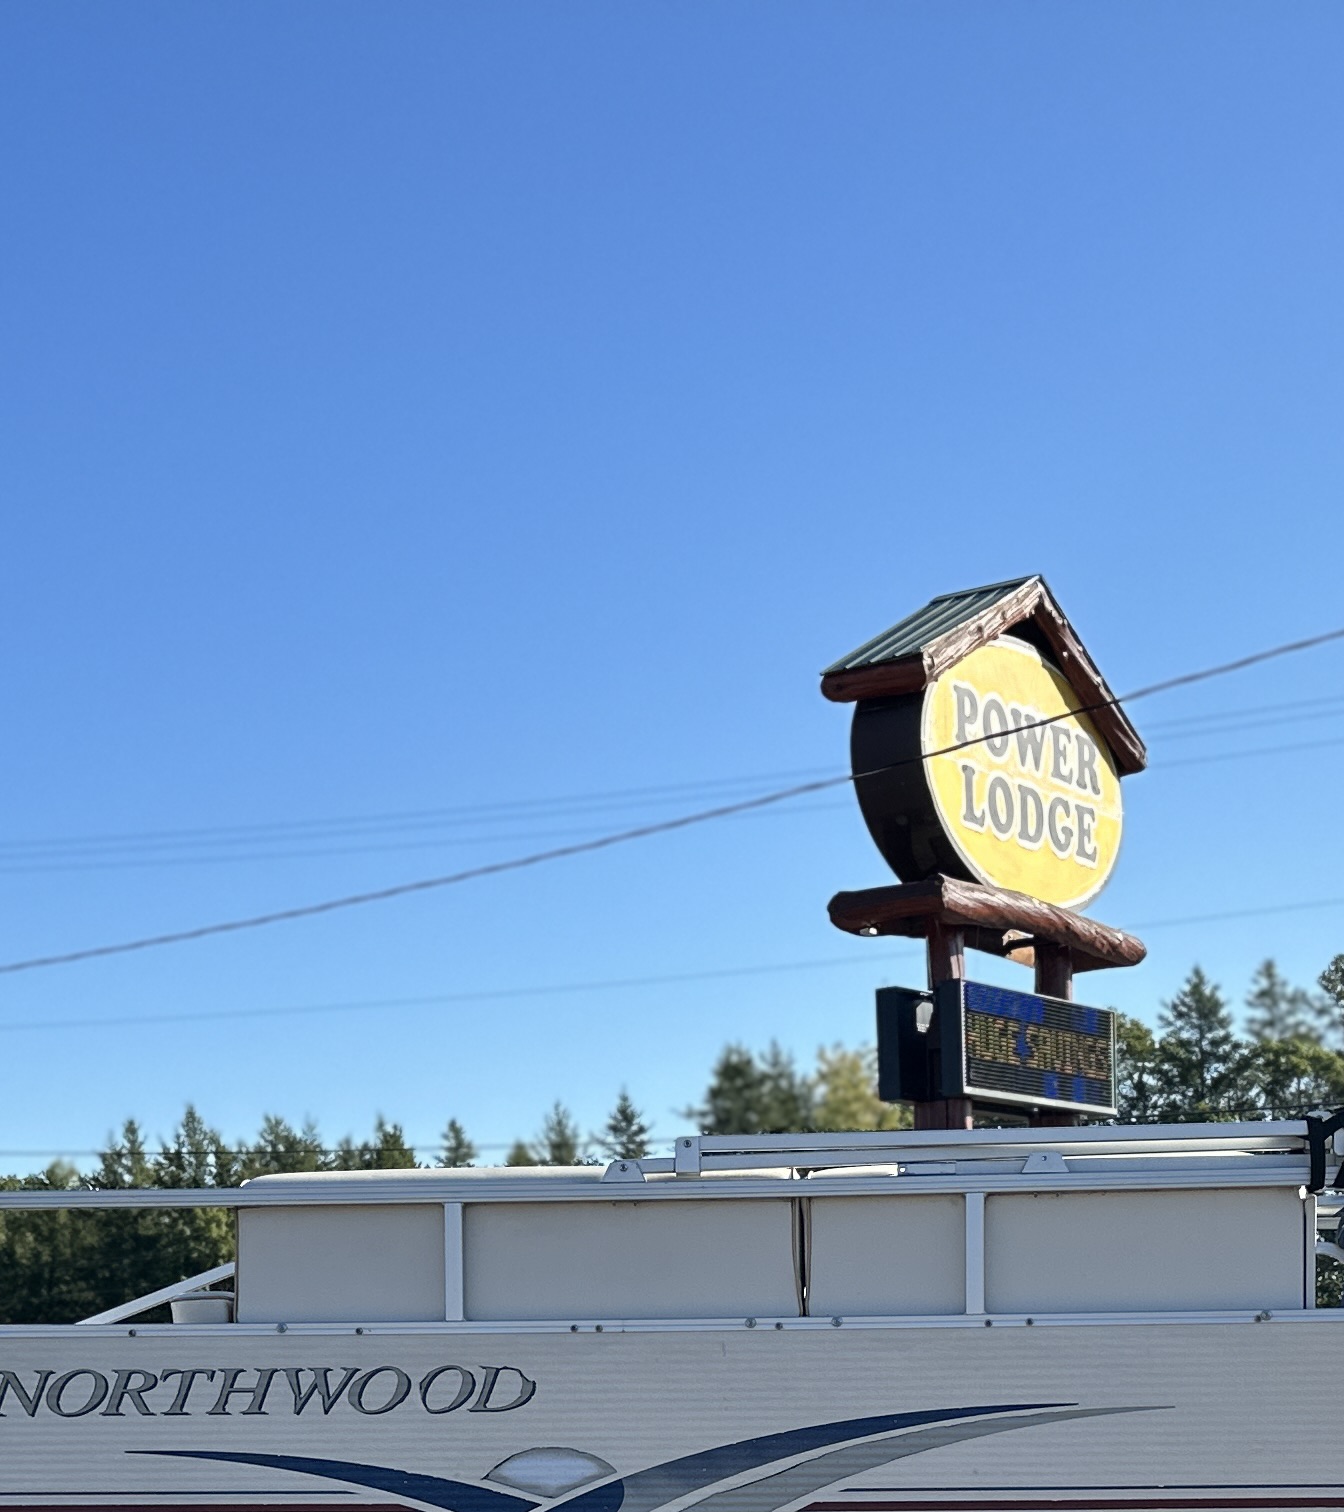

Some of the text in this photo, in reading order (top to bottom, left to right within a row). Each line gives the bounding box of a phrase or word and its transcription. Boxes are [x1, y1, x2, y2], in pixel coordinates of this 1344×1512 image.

[952, 684, 1101, 796] POWER
[961, 764, 1098, 864] LODGE
[966, 1012, 1110, 1081] HUGE SAVINGS
